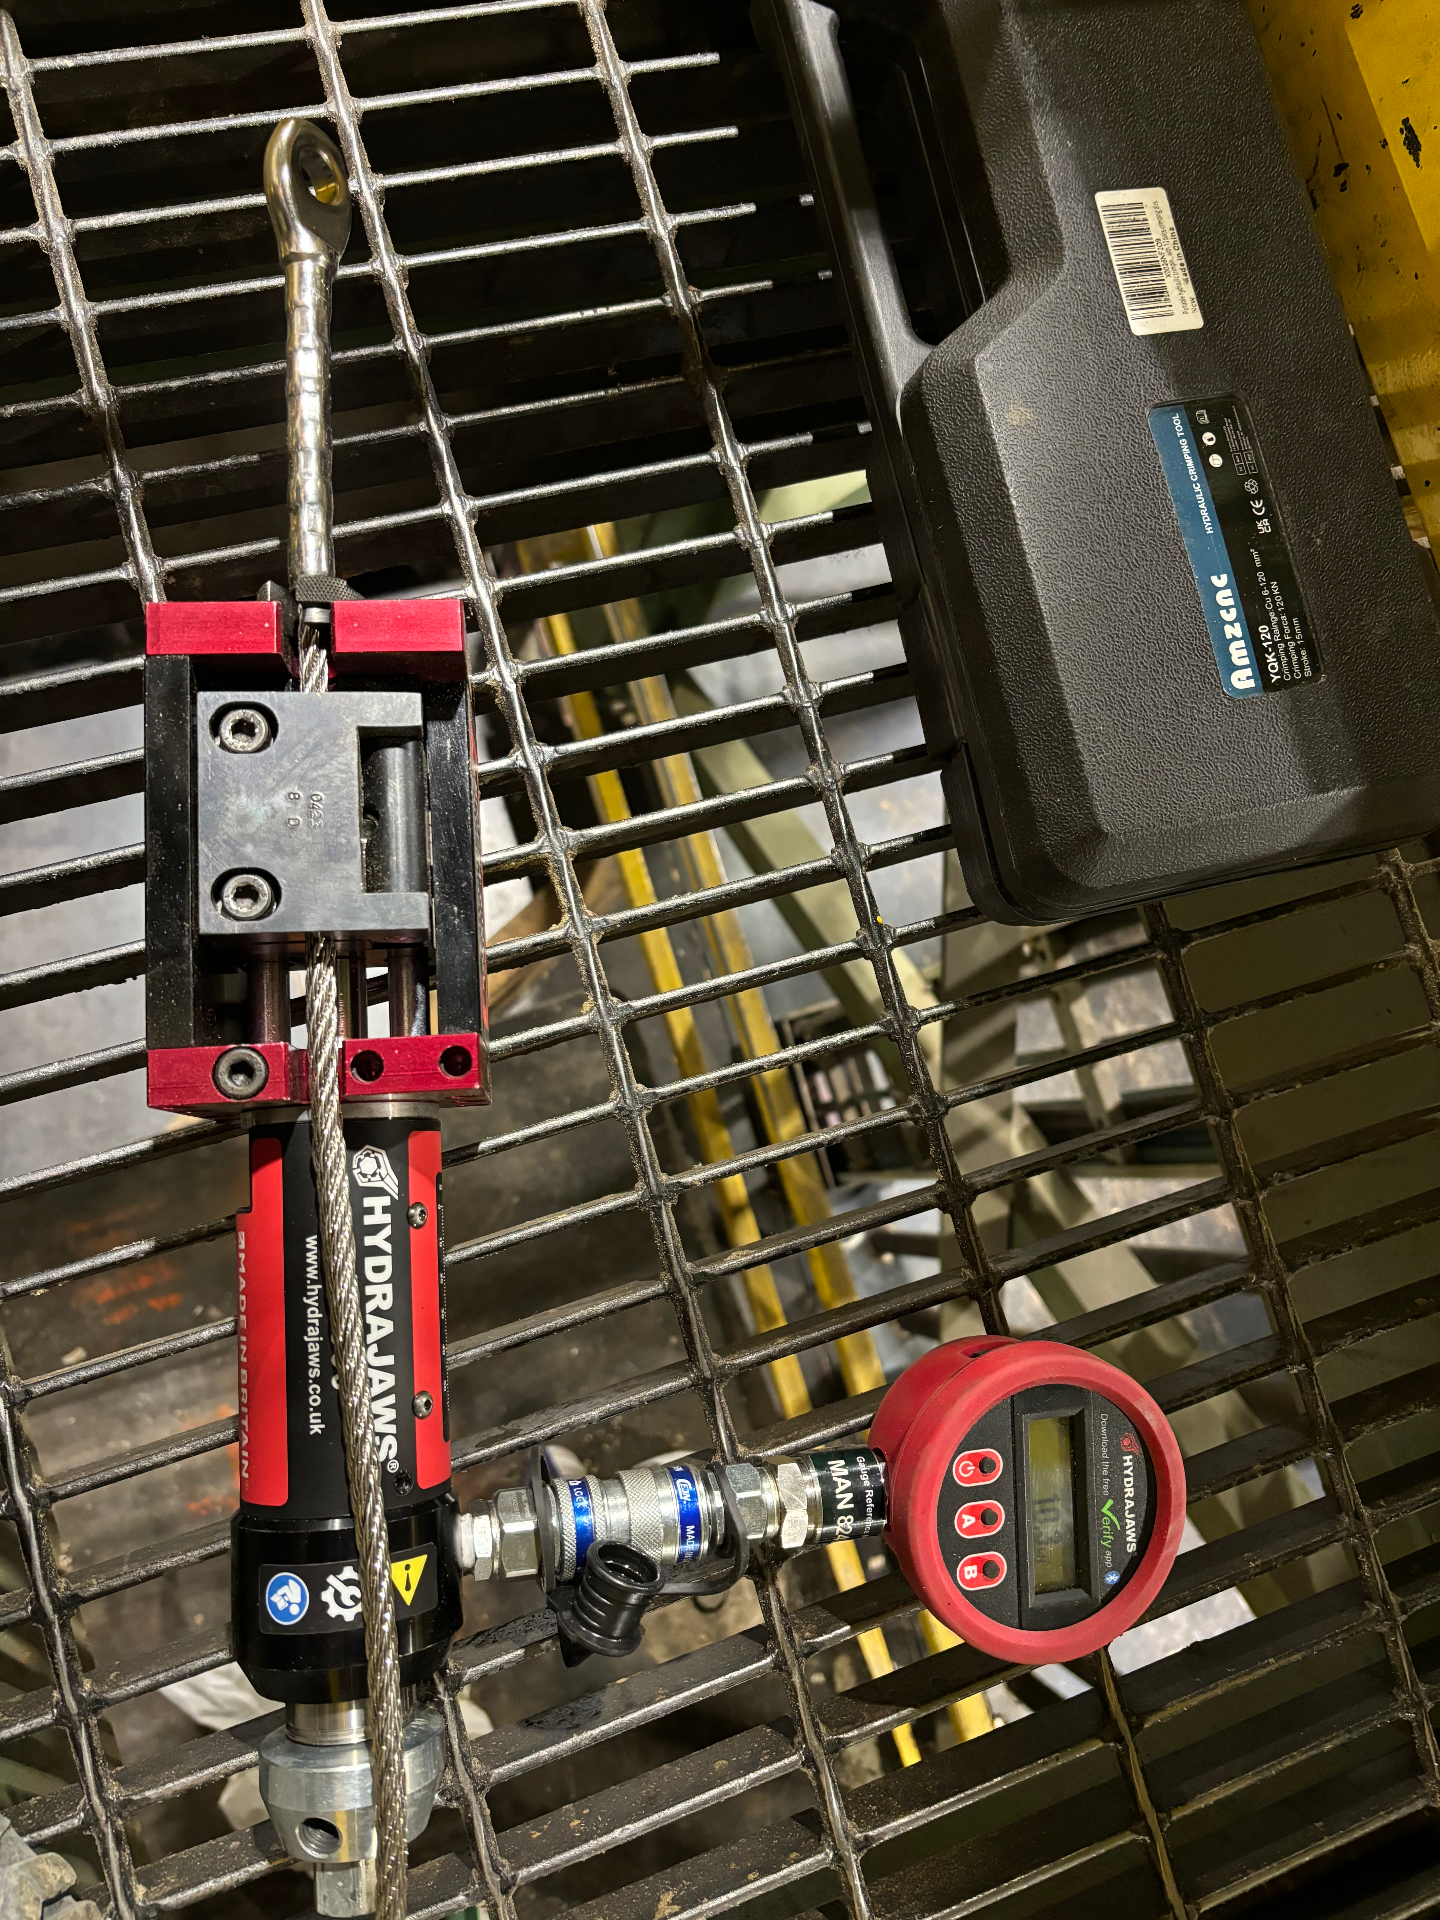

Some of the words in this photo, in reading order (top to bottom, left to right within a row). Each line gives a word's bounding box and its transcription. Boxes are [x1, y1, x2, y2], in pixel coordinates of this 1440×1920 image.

[1169, 227, 1180, 251] China
[1172, 413, 1185, 437] TOOL
[1179, 438, 1198, 481] CRIMPING
[1193, 483, 1213, 534] HYDRAULIC
[1257, 572, 1270, 596] 6-120
[1270, 581, 1280, 595] KN
[1275, 596, 1285, 611] 120
[1293, 617, 1304, 644] 15mm
[1258, 625, 1281, 683] YQK-120
[1277, 643, 1291, 681] Crimping
[1287, 641, 1301, 679] Crimping
[1300, 647, 1312, 677] Stroke:
[238, 1253, 246, 1328] MADE
[240, 1335, 246, 1362] IN
[302, 1235, 325, 1434] www.hydrajaws.co.uk
[240, 1368, 248, 1478] BRITAIN
[1099, 1413, 1108, 1457] Download
[1101, 1461, 1110, 1475] the
[827, 1459, 854, 1509] MAN
[856, 1455, 870, 1486] Gauge
[863, 1489, 874, 1533] Reference
[1102, 1478, 1110, 1495] free
[961, 1513, 975, 1528] A
[963, 1564, 977, 1579] B
[1104, 1550, 1112, 1567] app
